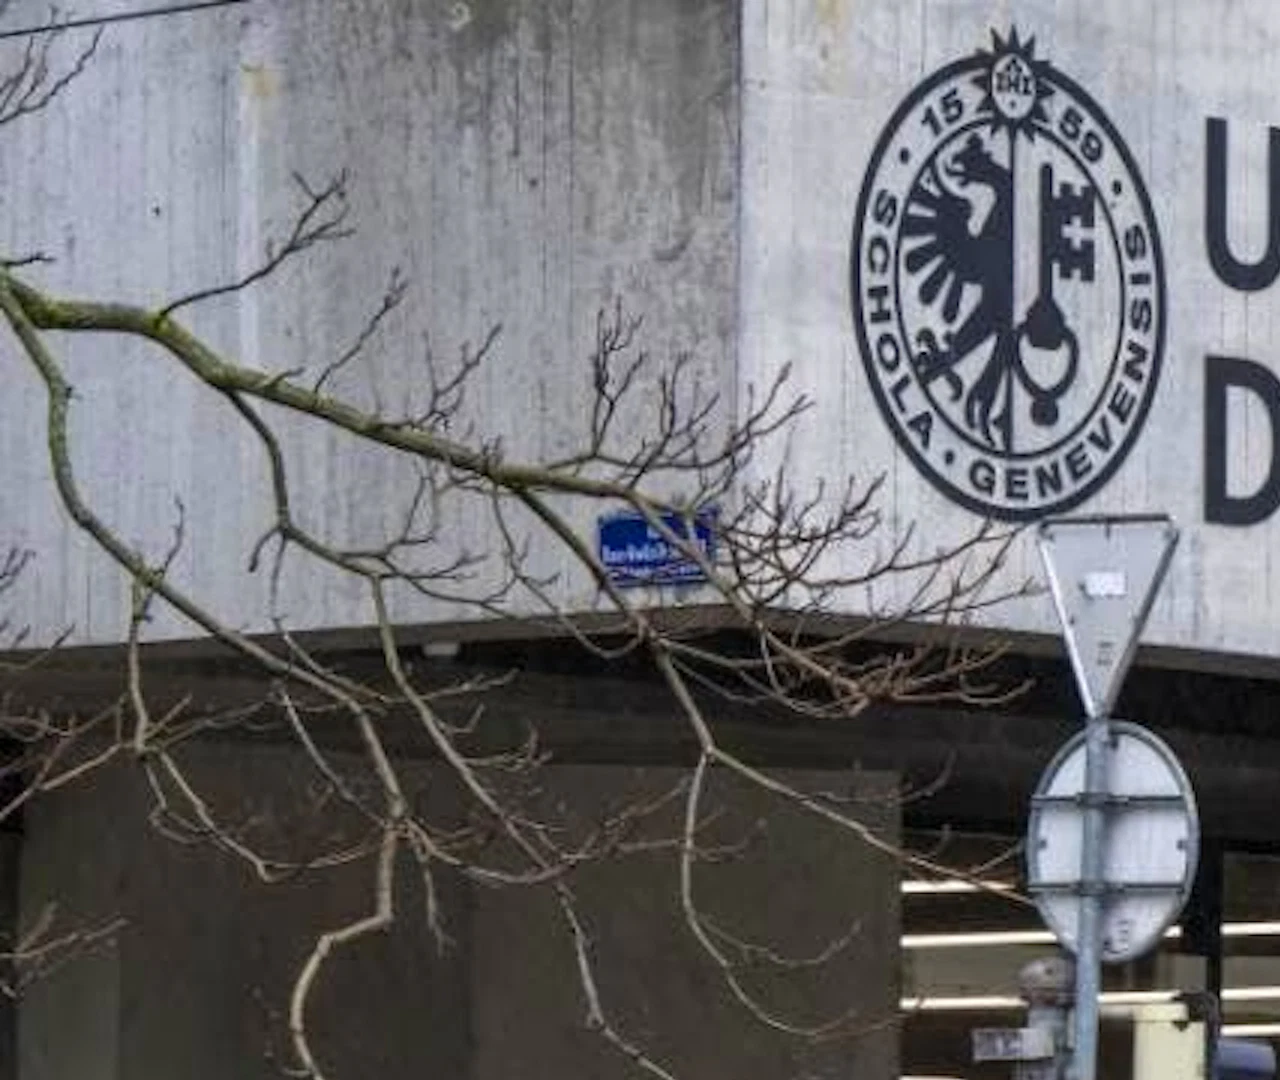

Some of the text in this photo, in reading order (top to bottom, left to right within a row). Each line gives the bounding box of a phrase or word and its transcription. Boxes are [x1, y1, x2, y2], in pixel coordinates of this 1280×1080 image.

[920, 88, 1103, 163] 15 59
[866, 188, 1152, 501] SCHOLA GENEVENSIS
